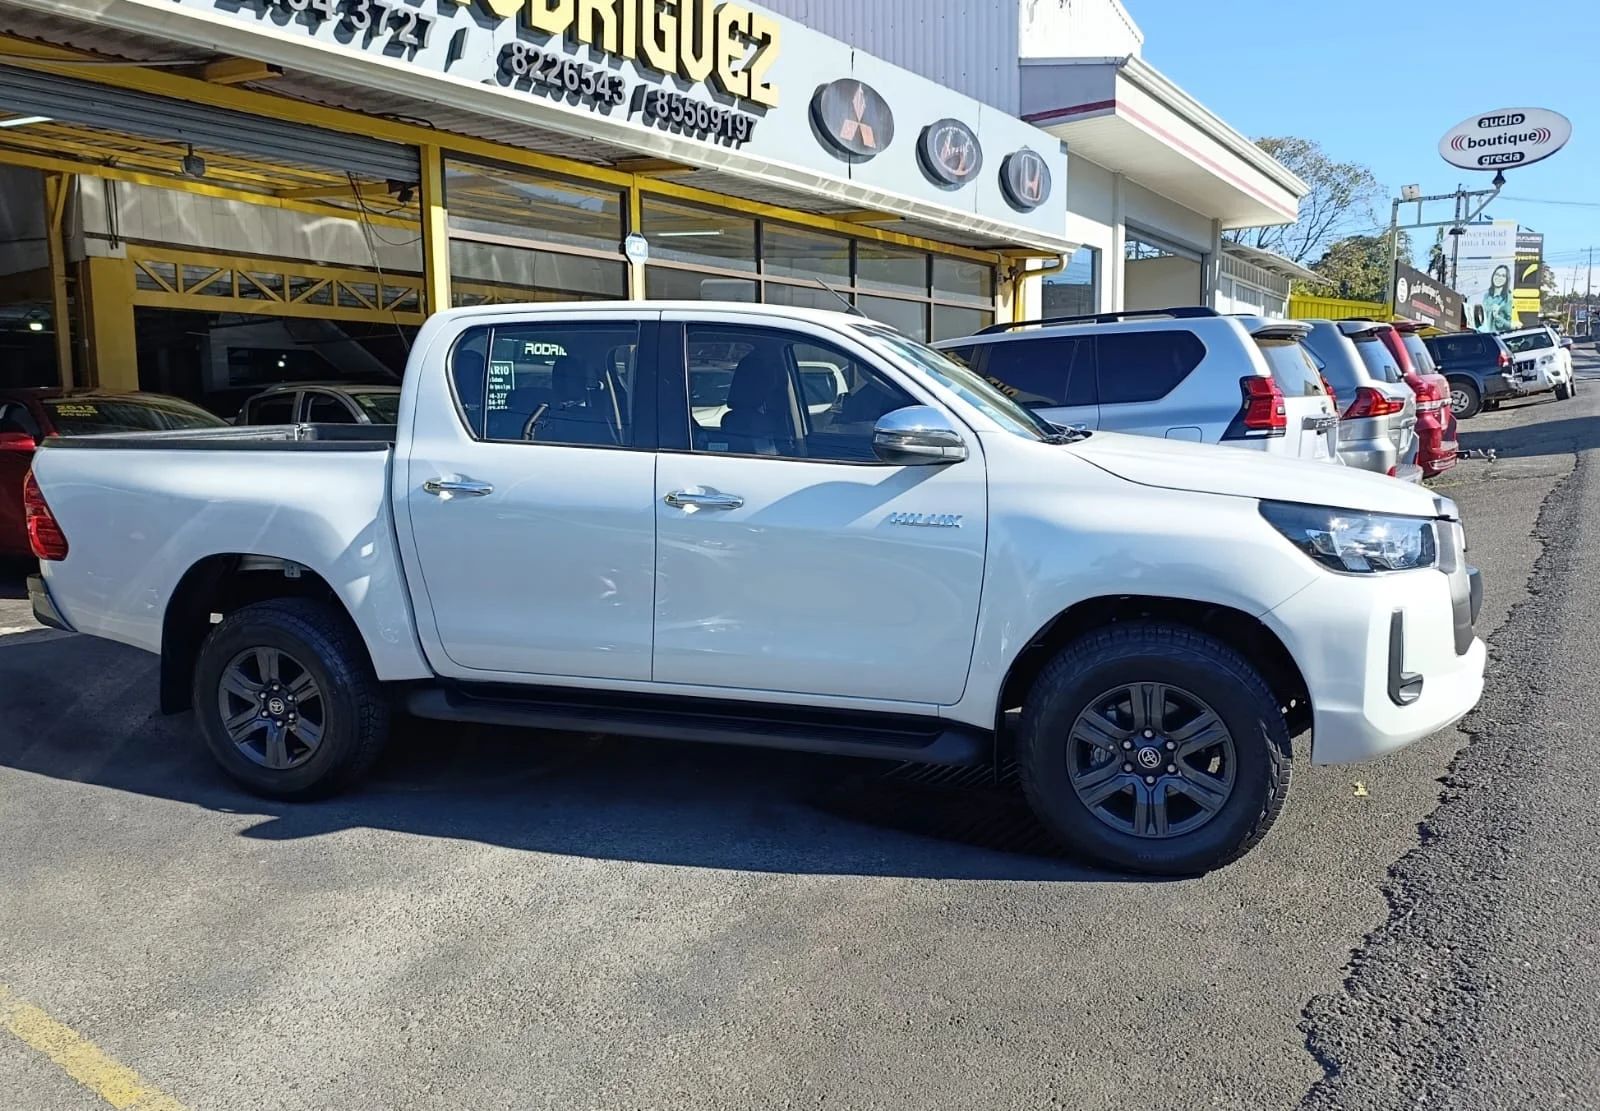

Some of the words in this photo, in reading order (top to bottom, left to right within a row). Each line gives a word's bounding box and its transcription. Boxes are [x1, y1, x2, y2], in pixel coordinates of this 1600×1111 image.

[351, 0, 437, 49] 3727
[511, 43, 626, 106] 8226543
[656, 89, 758, 142] 85569197
[1481, 114, 1523, 128] audio
[1467, 132, 1538, 149] boutique
[1480, 152, 1521, 166] grecia
[890, 512, 963, 528] HILUX
